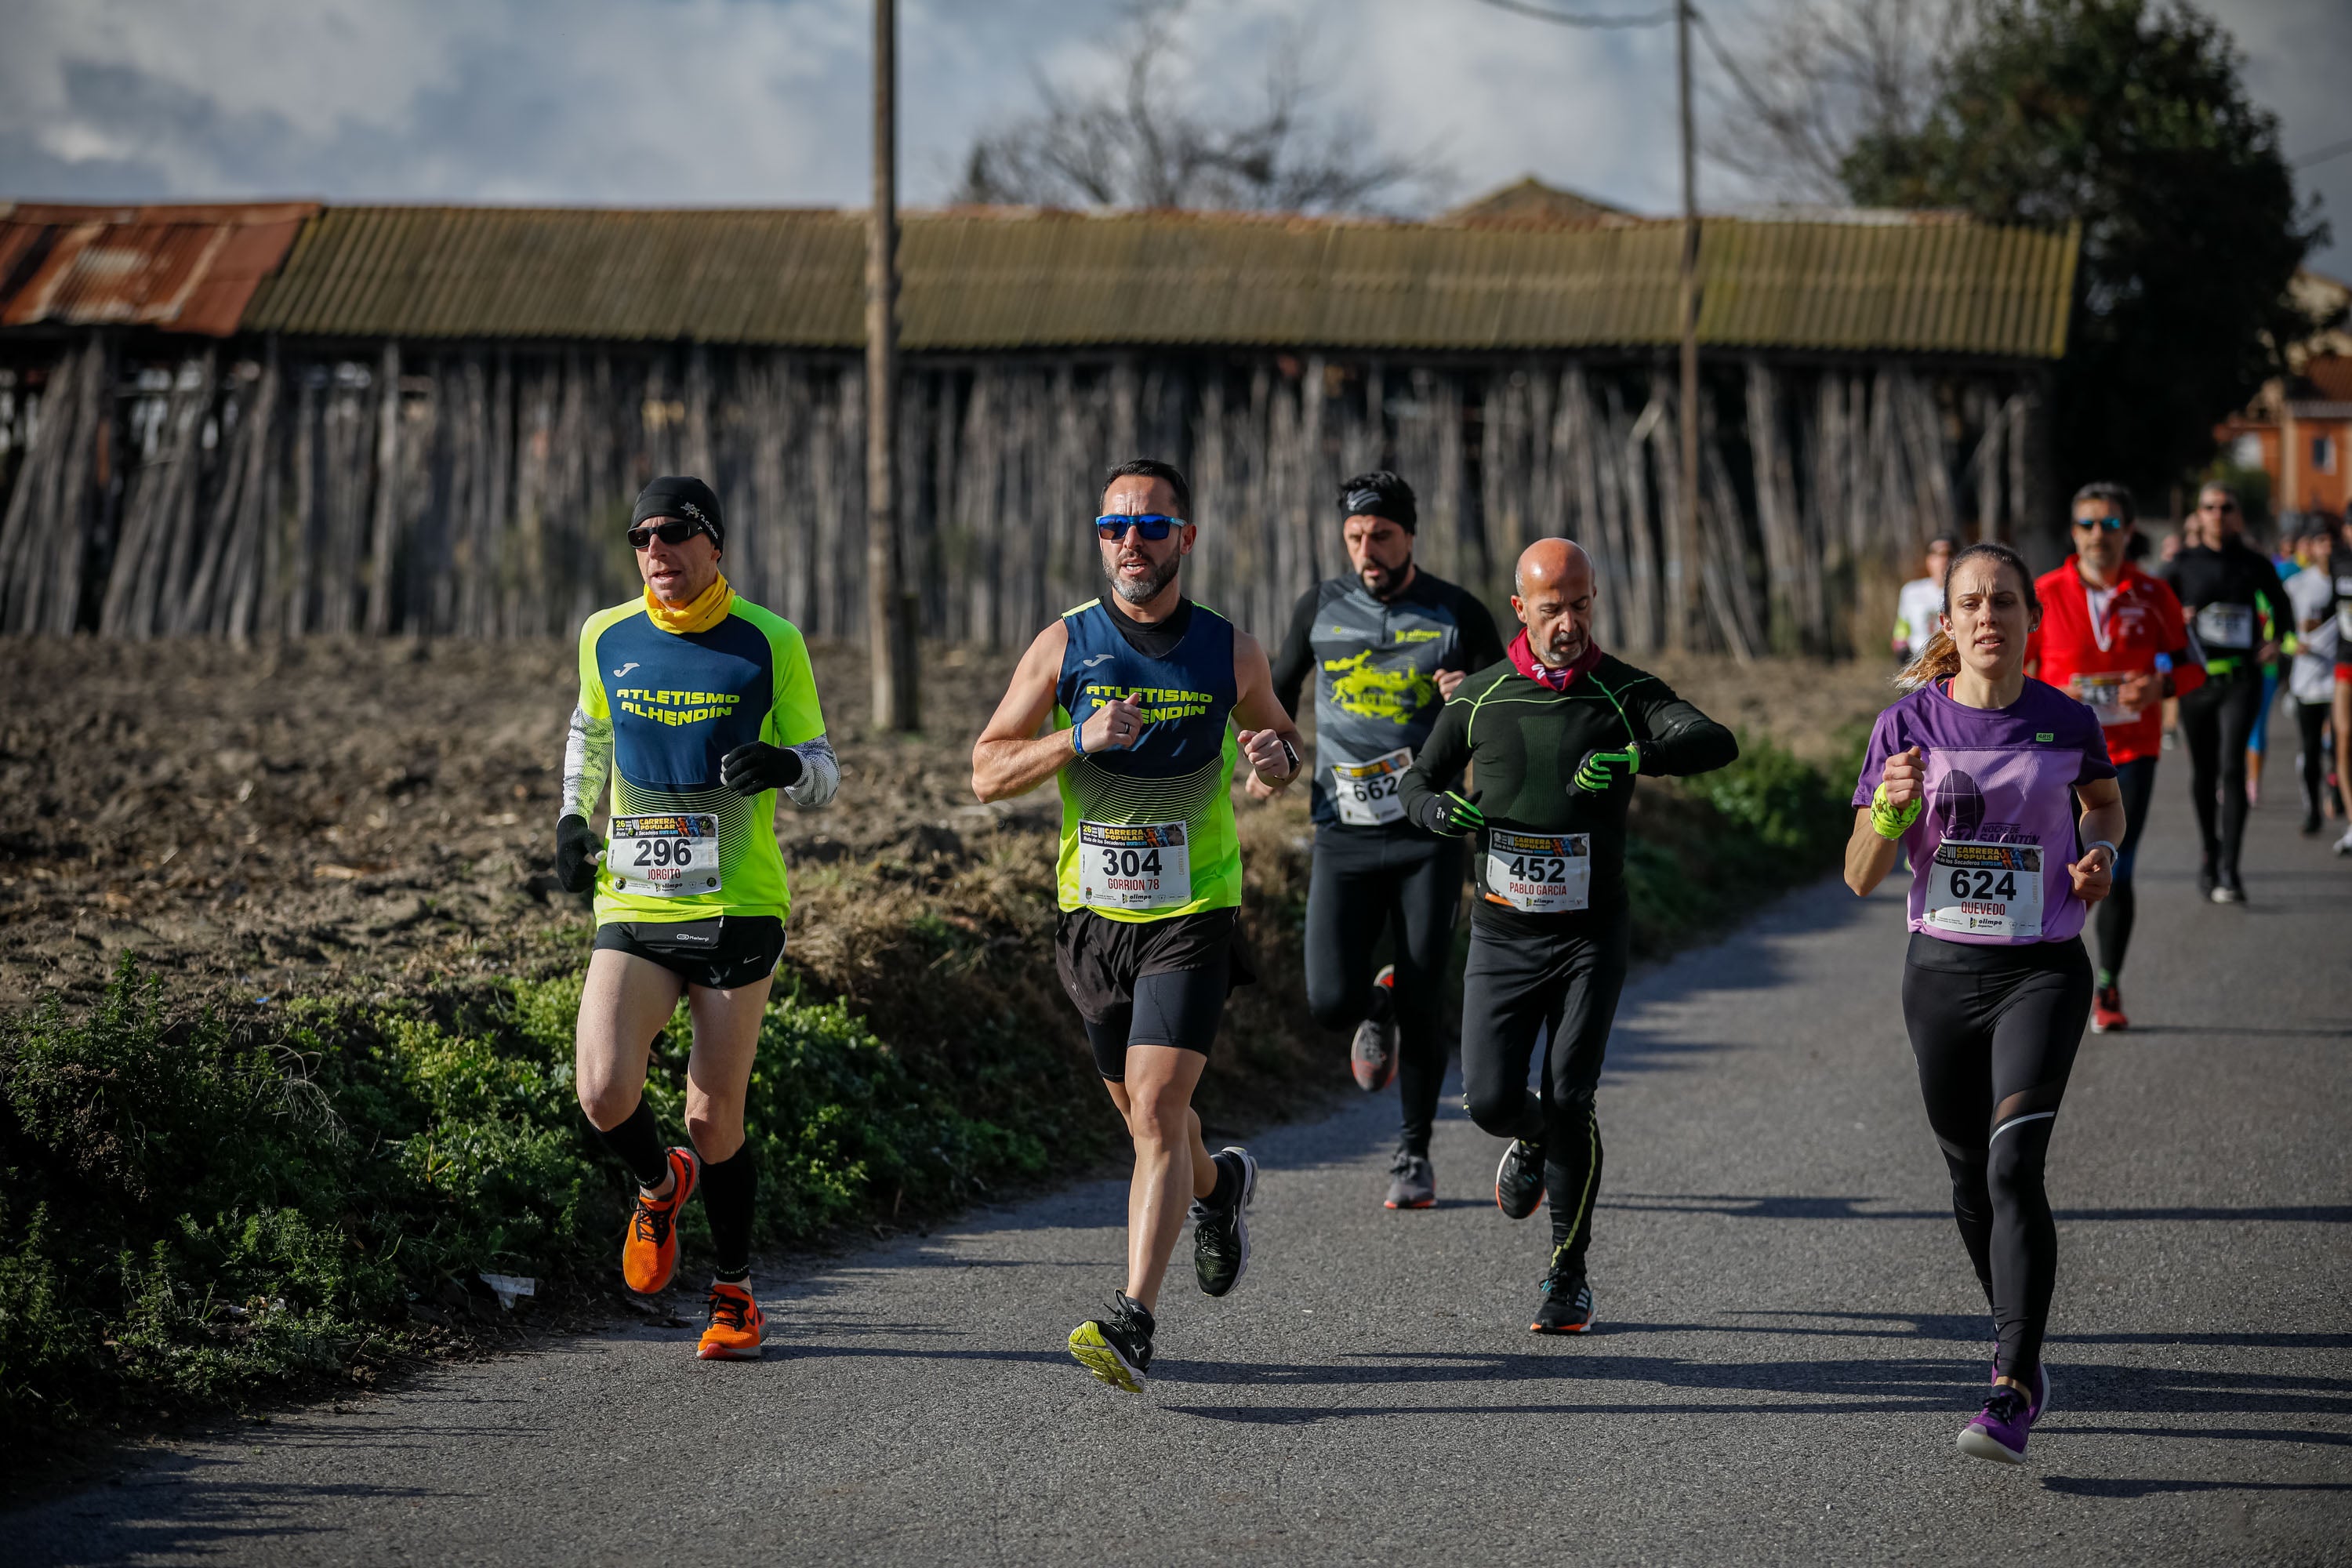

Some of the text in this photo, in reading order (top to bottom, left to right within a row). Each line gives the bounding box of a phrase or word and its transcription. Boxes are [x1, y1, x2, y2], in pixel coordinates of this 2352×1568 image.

[616, 689, 740, 706] ATLETISMO
[1086, 686, 1213, 702] ATLETISMO
[621, 702, 732, 727] ALHENDÍN
[1354, 776, 1398, 801] 662
[633, 839, 691, 866] 296
[1947, 847, 1956, 858] VII
[1956, 847, 1999, 855] CARRERA
[1102, 849, 1163, 877] 304
[1509, 856, 1566, 883] 452
[648, 869, 681, 880] JORGITO
[1108, 878, 1160, 891] GORRION 78
[1509, 882, 1567, 895] PABLO GARCÍA
[1951, 869, 2016, 901] 624
[1962, 902, 2005, 916] QUEVEDO
